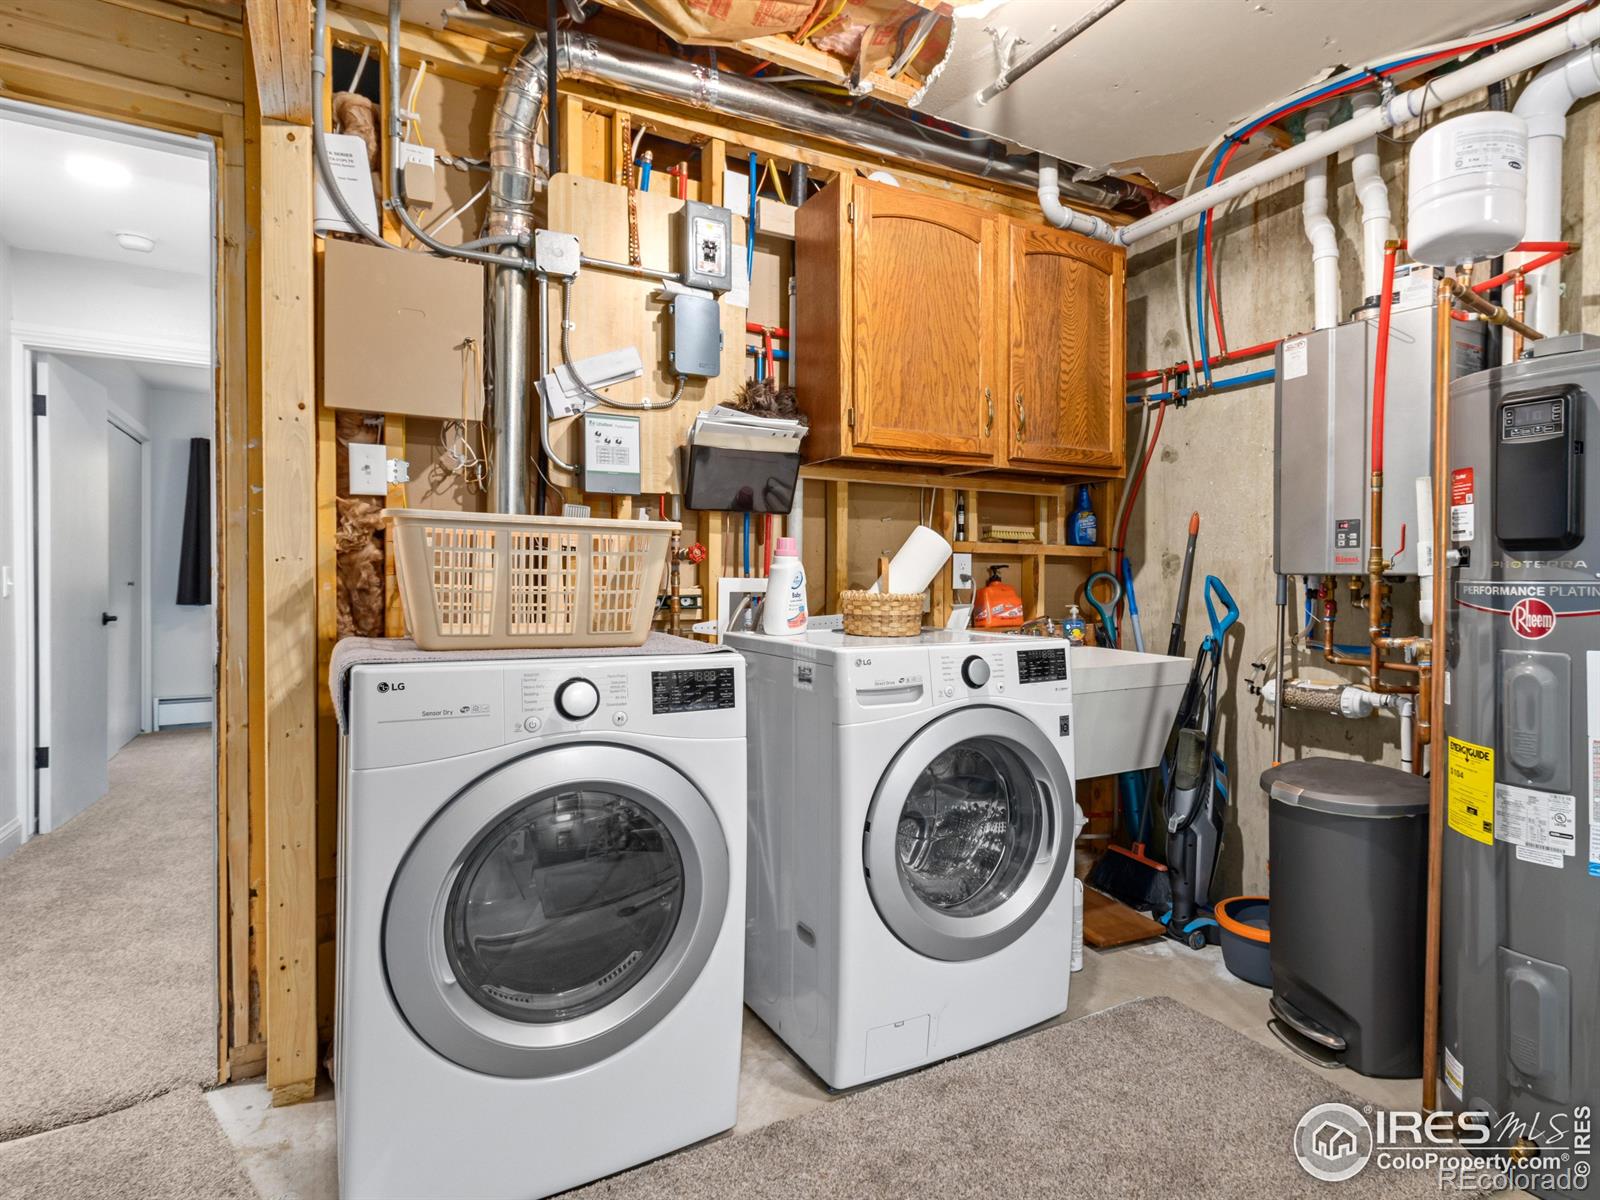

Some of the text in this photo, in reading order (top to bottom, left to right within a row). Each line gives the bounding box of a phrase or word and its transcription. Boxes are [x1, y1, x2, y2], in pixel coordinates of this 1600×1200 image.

[1463, 585, 1546, 597] PERFORMANCE
[1515, 600, 1552, 632] Rheem
[391, 682, 406, 691] LG
